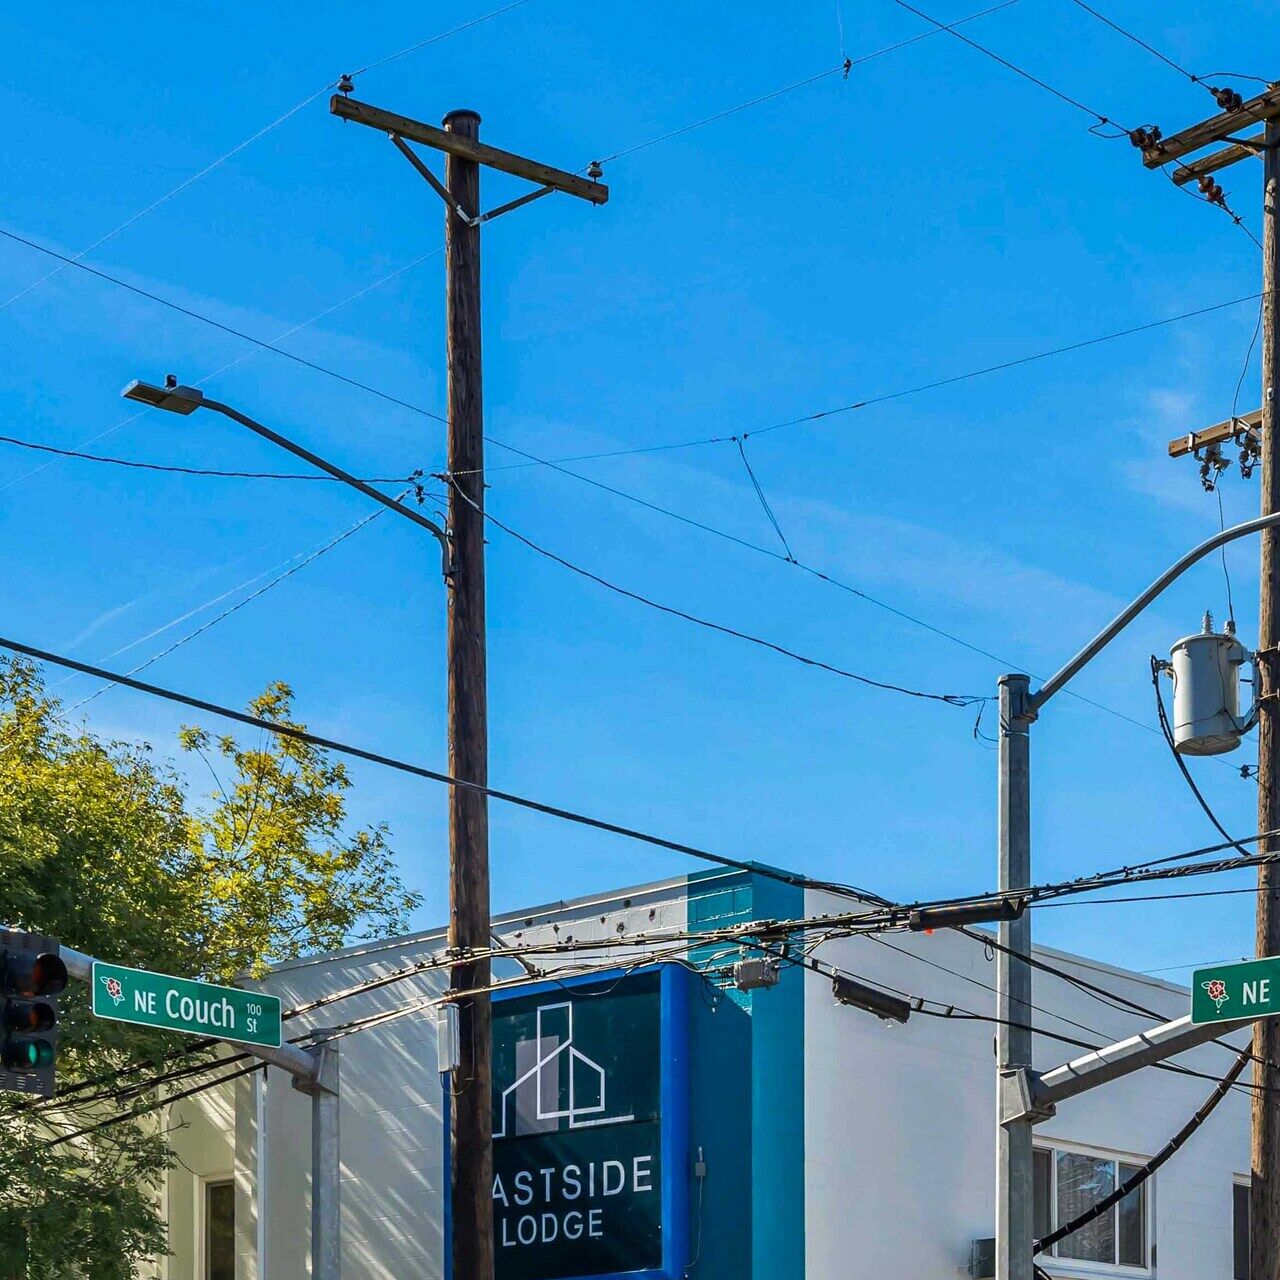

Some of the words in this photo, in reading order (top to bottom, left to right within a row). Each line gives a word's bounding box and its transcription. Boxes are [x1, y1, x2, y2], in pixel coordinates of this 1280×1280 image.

[1242, 979, 1270, 1005] NE
[134, 990, 157, 1015] NE
[165, 989, 235, 1029] Couch
[246, 1003, 262, 1016] 100
[246, 1017, 258, 1033] St
[502, 1209, 603, 1247] LODGE
